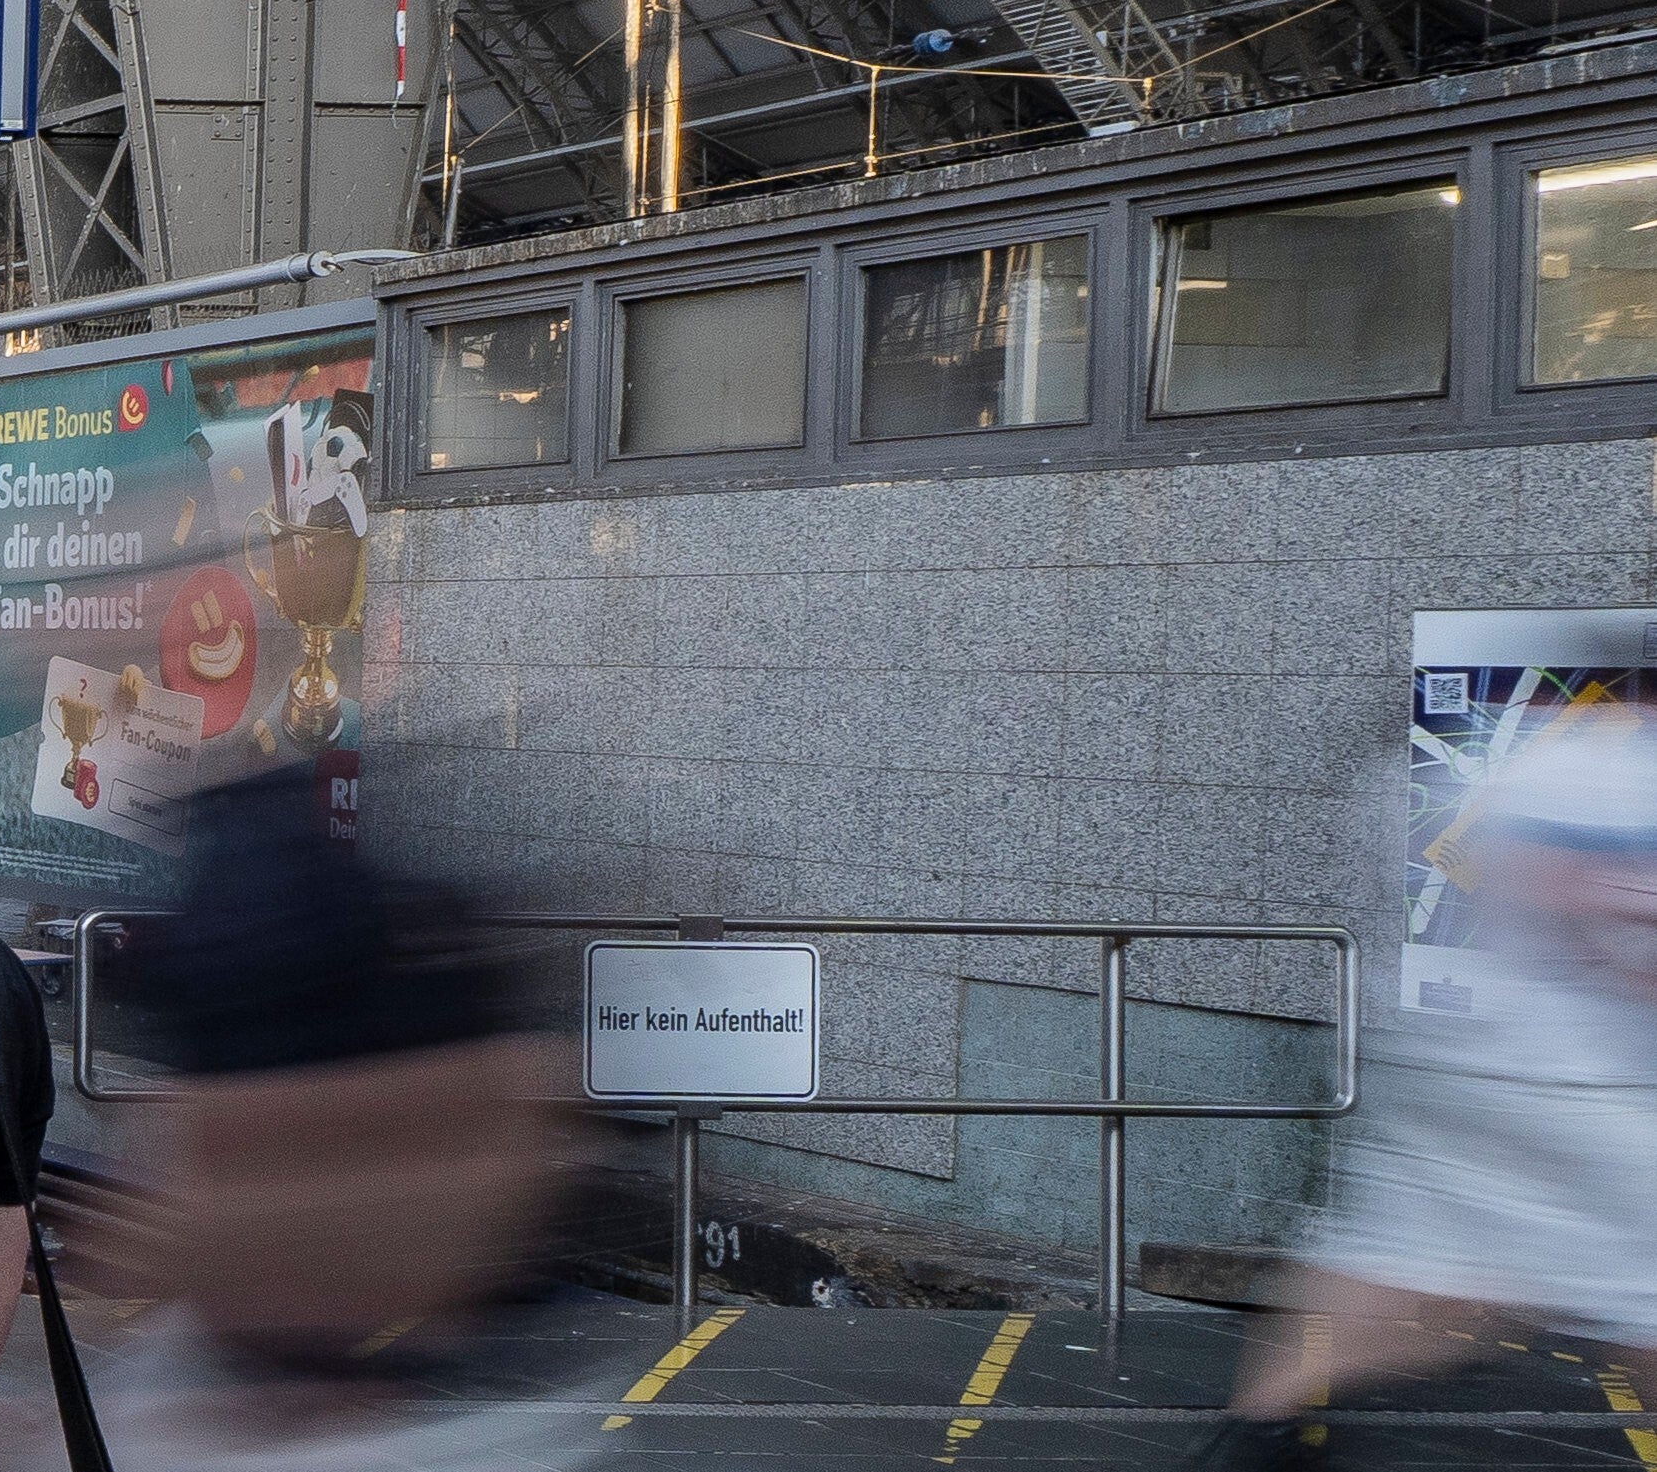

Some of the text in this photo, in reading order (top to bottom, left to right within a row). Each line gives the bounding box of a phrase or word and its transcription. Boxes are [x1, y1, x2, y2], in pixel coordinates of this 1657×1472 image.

[55, 406, 113, 439] Bonus
[4, 520, 143, 569] dir deinen
[121, 721, 192, 763] Fan-Coupon
[598, 1006, 804, 1033] Hier kein Aufenthalt!
